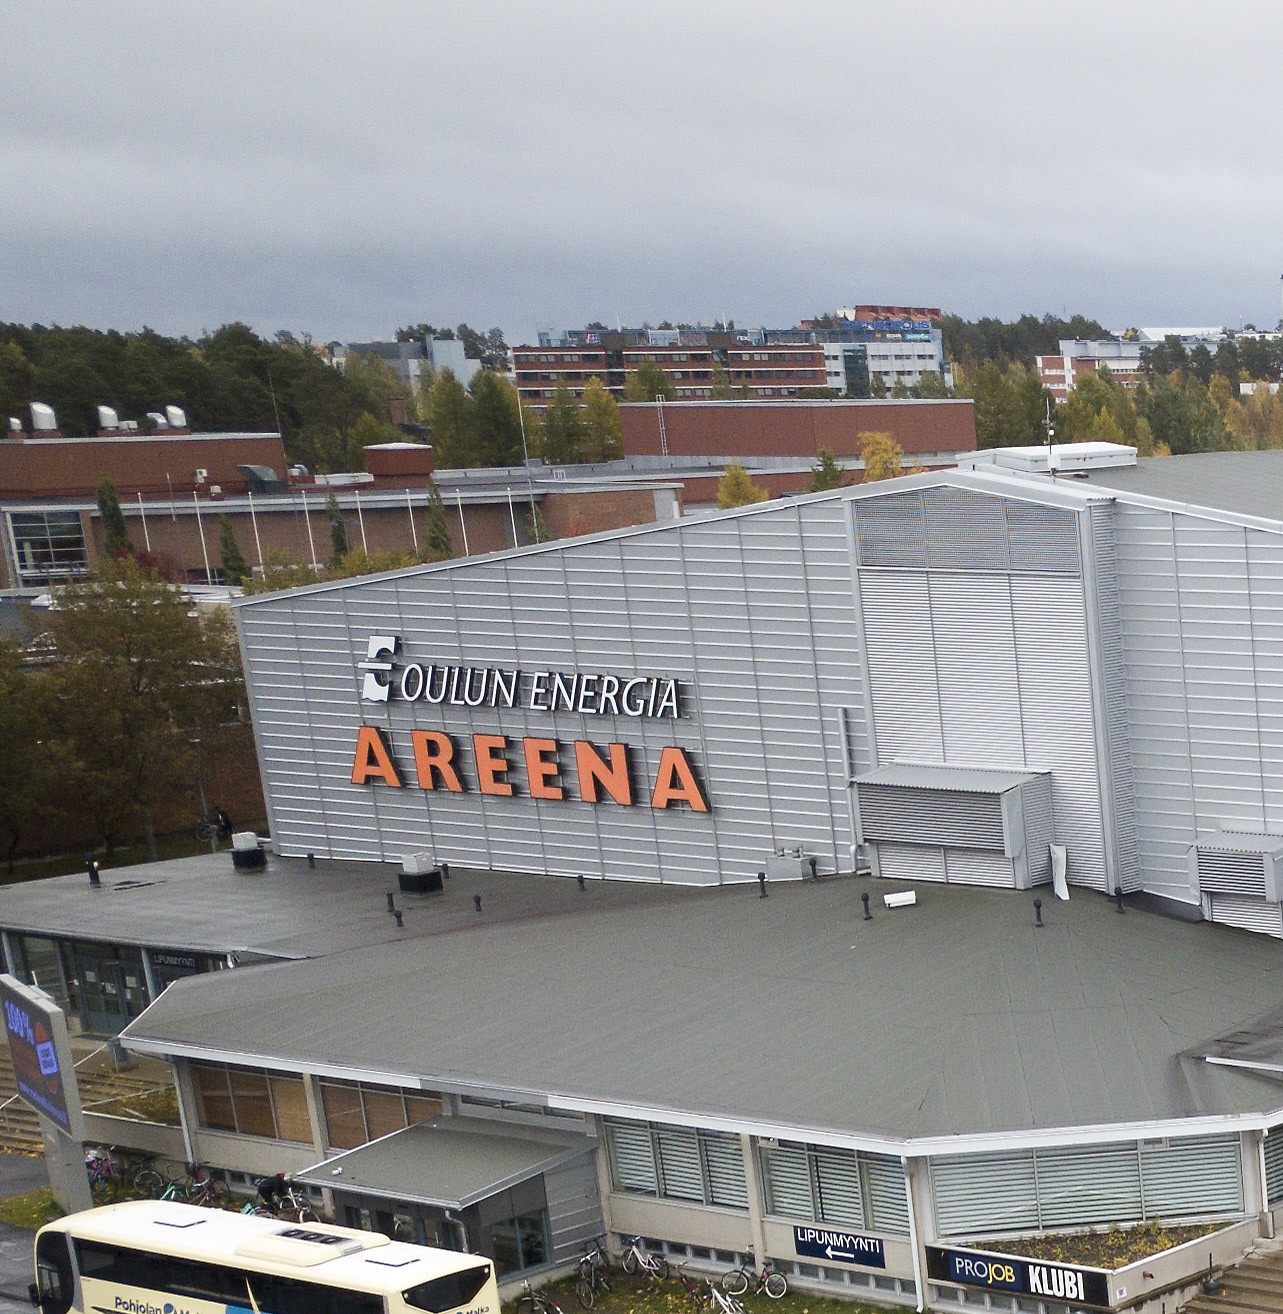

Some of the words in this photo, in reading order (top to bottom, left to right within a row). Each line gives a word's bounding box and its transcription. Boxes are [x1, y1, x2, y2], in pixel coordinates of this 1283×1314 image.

[400, 663, 519, 709] OULUN
[529, 671, 680, 719] ENERGIA
[351, 725, 710, 813] AREENA
[797, 1227, 880, 1254] LIPUNMYYNTI
[954, 1257, 1016, 1284] PROJOB
[1028, 1265, 1085, 1301] KLUBI
